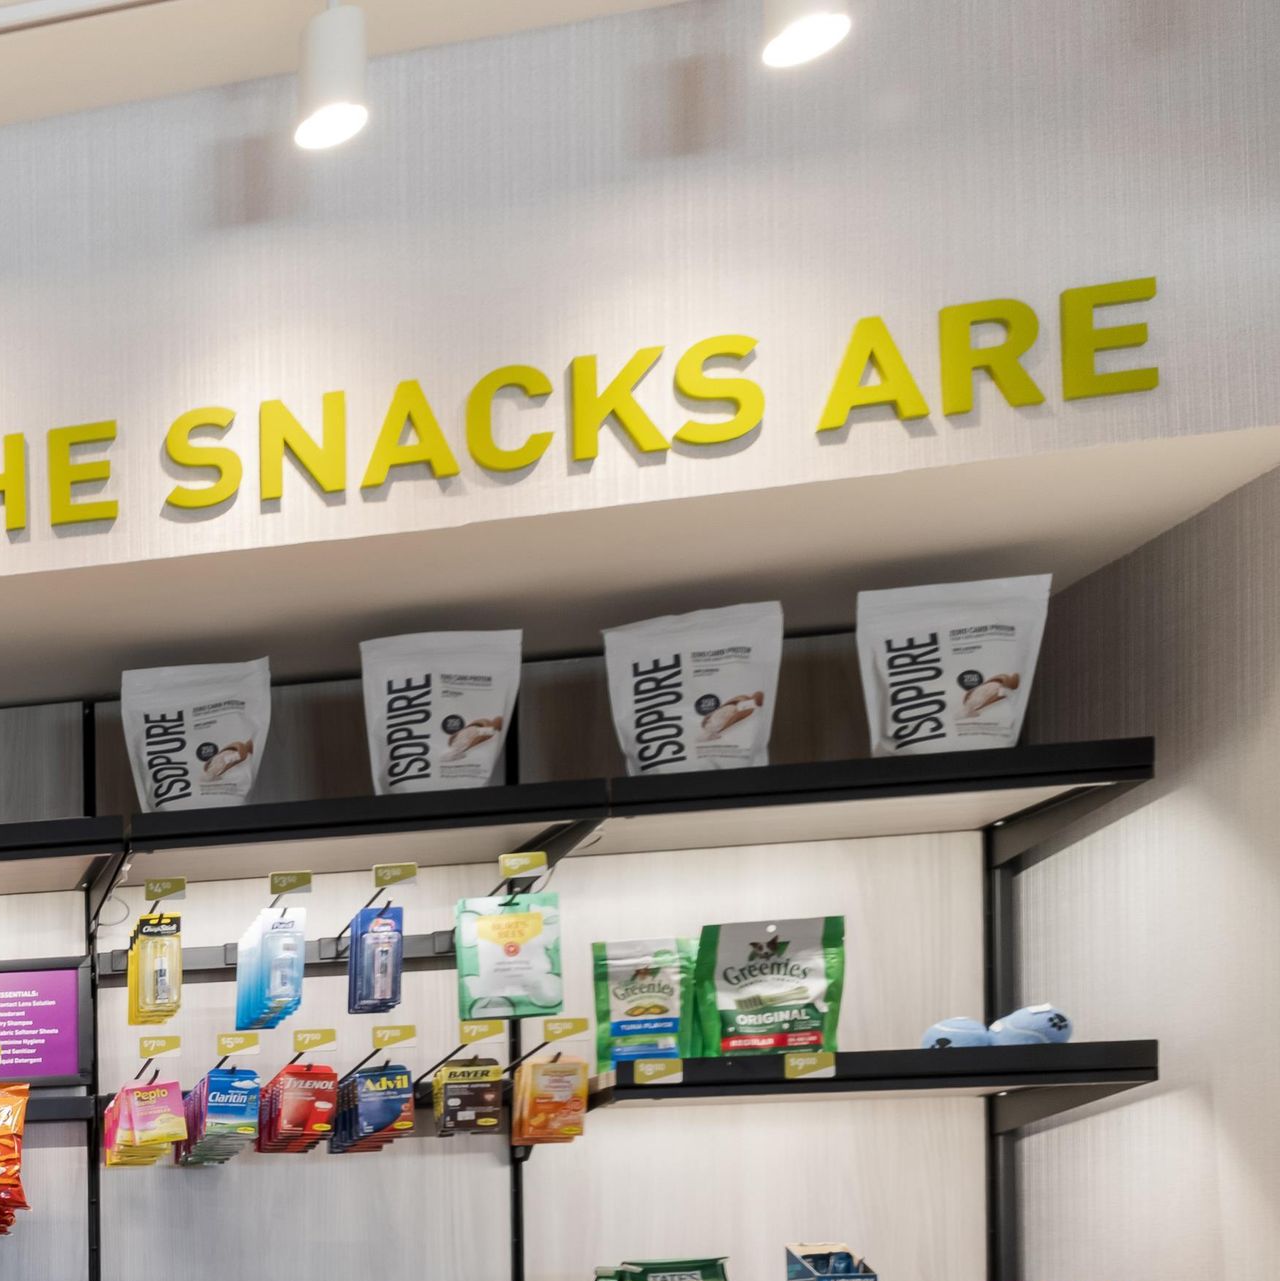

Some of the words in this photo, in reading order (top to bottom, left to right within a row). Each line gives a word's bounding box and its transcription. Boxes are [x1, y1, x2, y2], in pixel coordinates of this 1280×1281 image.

[162, 333, 767, 509] SNACKS
[815, 275, 1158, 433] ARE
[884, 631, 947, 750] ISOPURE
[632, 652, 687, 771] ISOPURE
[387, 672, 433, 787] ISOPURE
[143, 709, 192, 809] ISOPURE
[723, 961, 811, 986] Greenies
[612, 980, 674, 1001] Greenies
[736, 1007, 811, 1025] ORIGINAL
[283, 1077, 335, 1090] TYLENOL
[363, 1074, 408, 1093] Advil
[447, 1069, 491, 1079] BAYER
[133, 1088, 168, 1101] Pepto
[208, 1091, 247, 1103] Claritin
